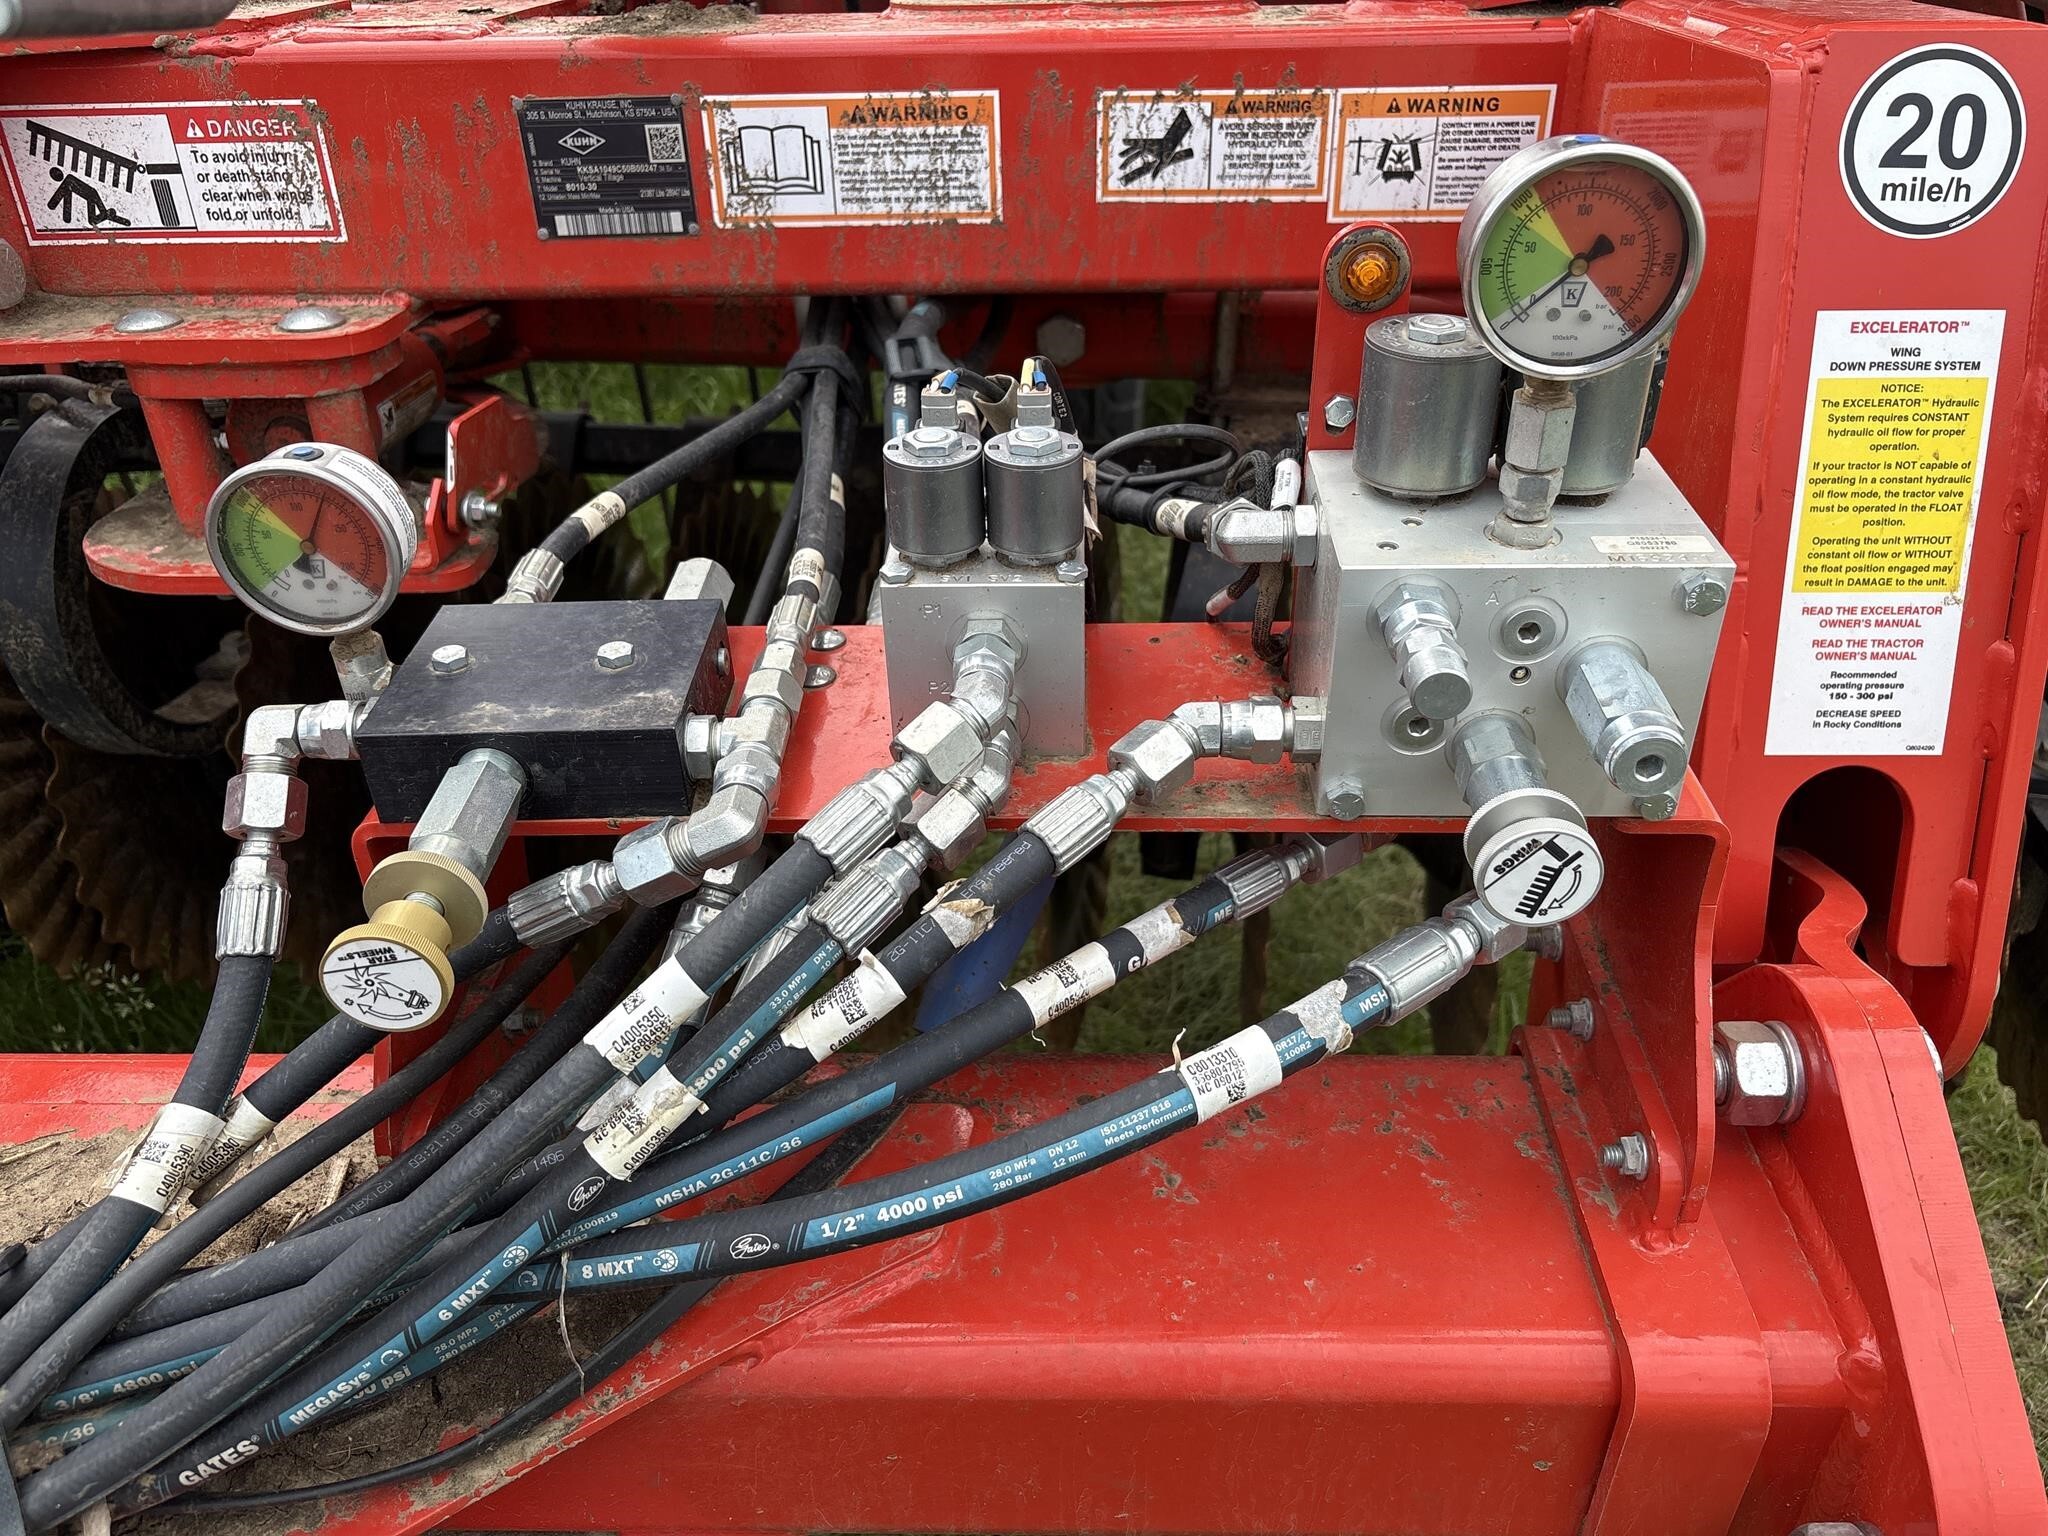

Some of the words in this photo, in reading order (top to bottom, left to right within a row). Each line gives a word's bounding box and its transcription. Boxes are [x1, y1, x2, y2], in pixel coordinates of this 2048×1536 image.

[566, 101, 586, 110] KUHN
[1242, 100, 1312, 114] WARNING
[1407, 97, 1501, 113] WARNING
[526, 112, 540, 120] 305
[550, 111, 573, 120] Monroe
[624, 109, 636, 117] KS
[636, 108, 656, 117] 67504
[662, 108, 677, 116] USA
[872, 105, 969, 122] WARNING
[206, 119, 298, 137] DANGER
[1878, 92, 1987, 170] 20
[566, 137, 598, 147] KUHN
[1228, 140, 1277, 148] HYDRAULIC
[190, 150, 209, 164] To
[213, 150, 249, 165] avoid
[560, 158, 582, 166] KUHN
[197, 172, 210, 183] or
[214, 169, 251, 183] death
[566, 183, 598, 192] 8010-30
[1880, 177, 1971, 202] mile/h
[202, 189, 233, 202] clear
[238, 189, 271, 202] when
[1510, 189, 1534, 211] 1000
[206, 208, 232, 221] fold
[236, 210, 248, 221] or
[1577, 204, 1593, 216] 100
[1620, 234, 1635, 246] 150
[1524, 242, 1537, 253] 50
[1890, 347, 1921, 357] WING
[1830, 362, 1866, 372] DOWN
[1868, 361, 1931, 371] PRESSURE
[1934, 360, 1981, 370] SYSTEM
[1881, 384, 1924, 392] NOTICE:
[1822, 399, 1840, 408] The
[1932, 398, 1980, 408] Hydraulic
[1828, 414, 1865, 424] System
[1868, 413, 1909, 424] requires
[1912, 412, 1970, 422] CONSTANT
[1828, 428, 1874, 438] hydraulic
[1876, 428, 1889, 437] oil
[1892, 428, 1914, 437] flow
[1915, 428, 1930, 437] for
[1932, 428, 1966, 438] proper
[1870, 442, 1920, 453] operation.
[1813, 461, 1820, 470] If
[1822, 463, 1844, 472] your
[1848, 462, 1881, 470] tractor
[1884, 461, 1892, 470] is
[1894, 461, 1918, 470] NOT
[1920, 460, 1958, 471] capable
[1961, 460, 1972, 470] of
[1808, 476, 1856, 486] operating
[1859, 476, 1868, 484] in
[1880, 476, 1923, 484] constant
[1926, 475, 1972, 486] hydraulic
[1812, 490, 1824, 499] oil
[1827, 489, 1848, 499] flow
[1851, 489, 1881, 500] mode,
[1884, 490, 1900, 498] the
[1902, 490, 1935, 498] tractor
[1938, 489, 1964, 498] valve
[1812, 537, 1861, 547] Operating
[1864, 536, 1879, 546] the
[1882, 536, 1900, 545] unit
[1904, 536, 1952, 545] WITHOUT
[1485, 591, 1499, 606] A
[922, 603, 942, 618] P1
[1802, 606, 1832, 615] READ
[1836, 606, 1857, 615] THE
[1860, 606, 1943, 615] EXCELERATOR
[1819, 619, 1872, 628] OWNER'S
[1874, 619, 1922, 628] MANUAL
[1812, 639, 1843, 648] READ
[1846, 639, 1868, 648] THE
[1872, 639, 1924, 648] TRACTOR
[1815, 652, 1868, 660] OWNER'S
[1870, 652, 1917, 660] MANUAL
[1830, 671, 1897, 679] Recommended
[1820, 682, 1863, 690] operating
[1865, 682, 1904, 690] pressure
[1829, 692, 1847, 700] 150
[1856, 692, 1876, 700] 300
[1878, 692, 1894, 702] psi
[1816, 710, 1868, 718] DECREASE
[1870, 710, 1902, 718] SPEED
[1823, 720, 1851, 730] Rocky
[1854, 720, 1902, 729] Conditions
[1493, 838, 1543, 876] WINGS
[368, 954, 398, 964] STAR
[769, 990, 789, 1010] 33.0
[788, 972, 808, 992] MPa
[812, 950, 828, 965] DN
[826, 940, 838, 953] 10
[728, 1028, 756, 1060] psi
[1100, 1124, 1118, 1137] ISO
[1119, 1110, 1150, 1130] 11237
[1151, 1100, 1172, 1114] R16
[1104, 1128, 1135, 1146] Meets
[1135, 1102, 1194, 1134] Performance
[988, 1166, 1012, 1180] 28.0
[1014, 1156, 1037, 1170] MPa
[1048, 1145, 1064, 1158] DN
[1065, 1139, 1079, 1152] 12
[654, 1178, 708, 1209] MSHA
[710, 1136, 802, 1184] 2G-11C/36
[992, 1178, 1013, 1192] 280
[1016, 1172, 1033, 1184] Bar
[1052, 1158, 1066, 1169] 12
[1068, 1151, 1087, 1163] mm
[876, 1197, 928, 1222] 4000
[932, 1185, 964, 1210] psi
[582, 1264, 594, 1280] 8
[437, 1309, 454, 1322] 6
[112, 1372, 164, 1394] 4800
